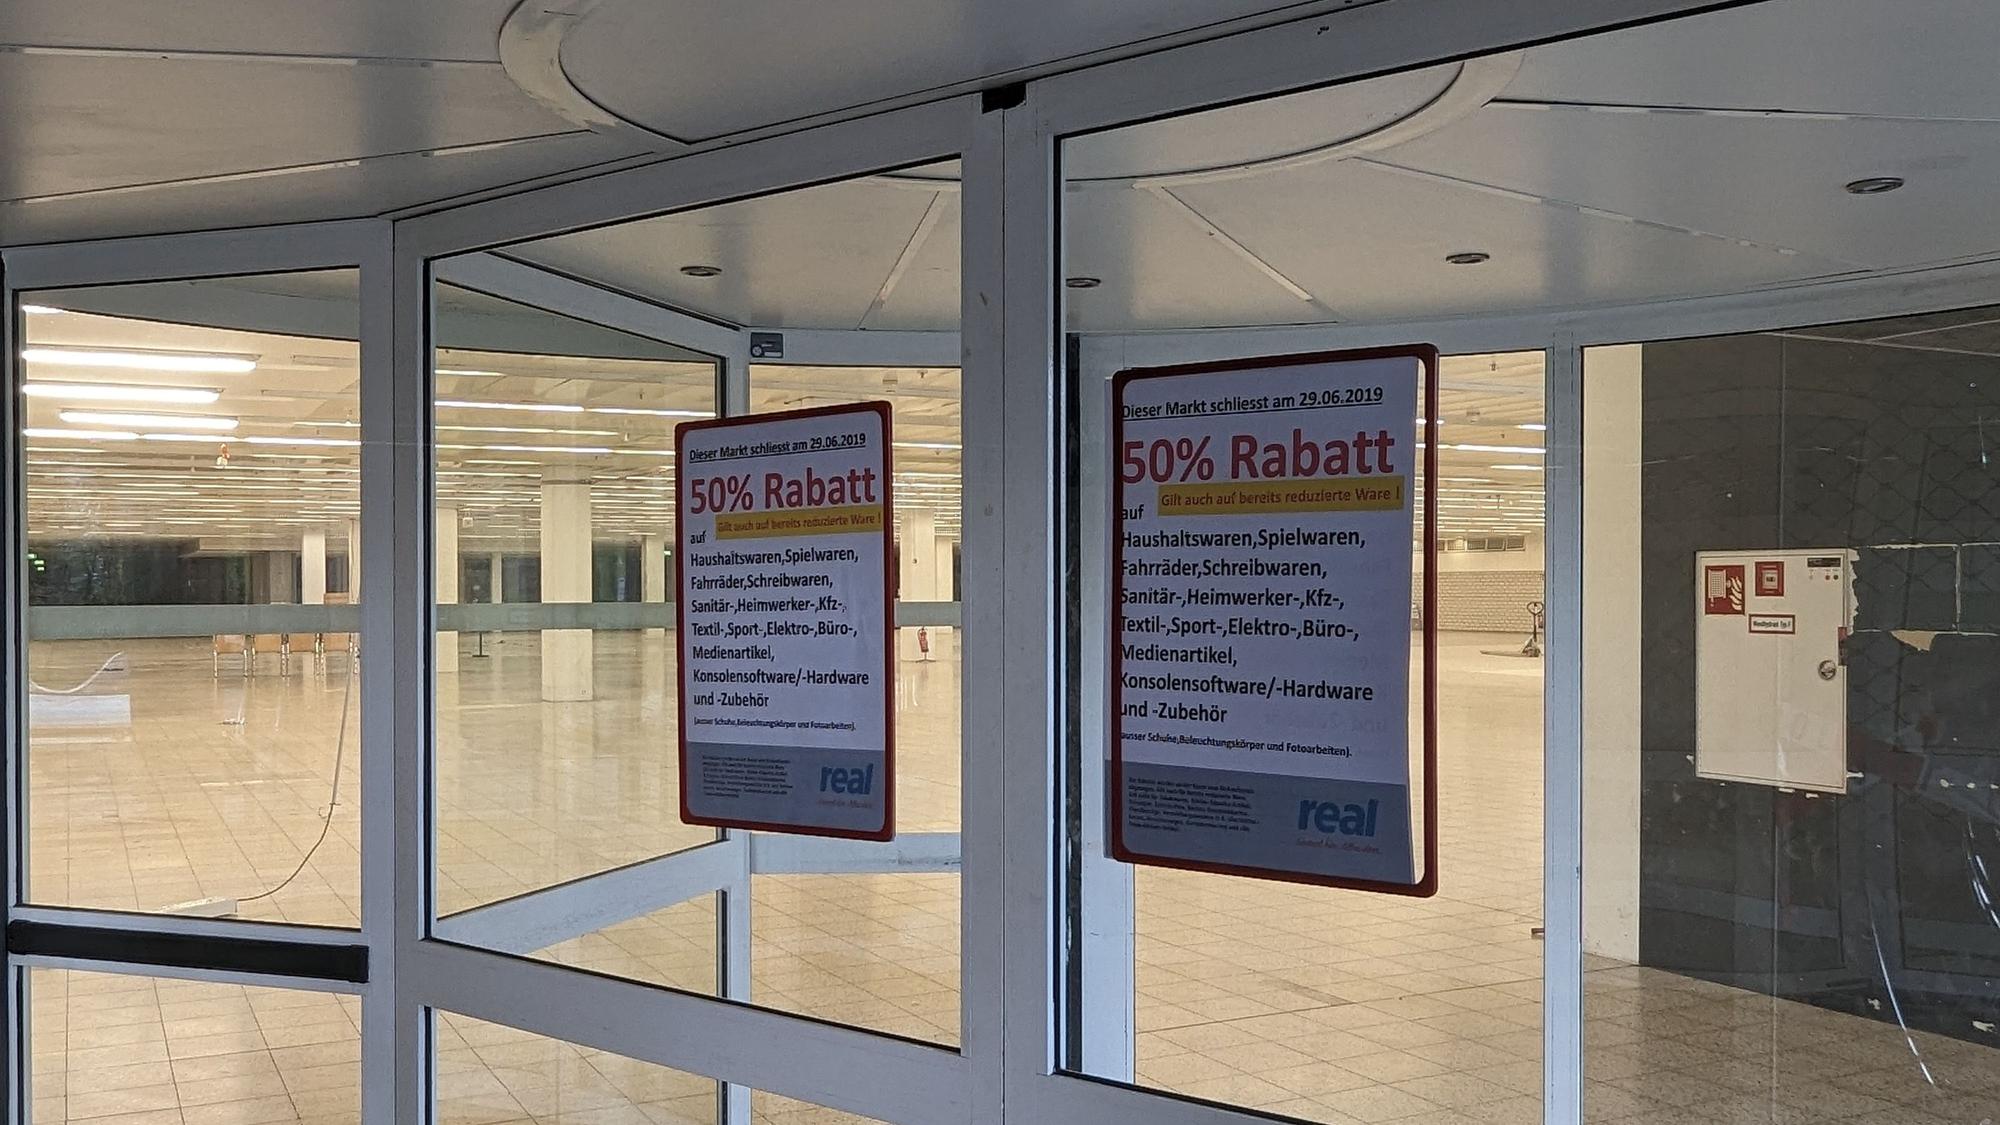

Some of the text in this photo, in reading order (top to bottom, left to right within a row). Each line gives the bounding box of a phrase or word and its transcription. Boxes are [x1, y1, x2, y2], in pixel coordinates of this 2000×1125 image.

[1122, 387, 1383, 419] Dieser Markt schliesst am 29.06.2019
[689, 433, 866, 461] Dieser Markt schliesst am 29.06.2019
[1122, 428, 1395, 484] 50% Rabatt
[691, 467, 876, 514] 50% Rabatt
[1161, 492, 1181, 506] Gilt
[1185, 492, 1213, 505] auch
[1216, 491, 1236, 505] auf
[1240, 489, 1280, 504] bereits
[1285, 488, 1351, 503] reduzierte
[1355, 487, 1391, 500] Ware
[771, 516, 801, 529] bereits
[803, 514, 848, 528] reduzierte
[851, 512, 875, 525] Ware
[1120, 504, 1144, 520] auf
[690, 529, 707, 545] auf
[691, 548, 859, 567] Haushaltswaren,Spielwaren,
[691, 573, 834, 591] Fahrräder,Schreibwaren,
[692, 645, 775, 662] Medienartikel,
[1120, 644, 1238, 667] Medienartikel,
[693, 668, 870, 687] Konsolensoftware/-Hardware
[1120, 672, 1373, 701] Konsolensoftware/-Hardware
[694, 692, 770, 707] und -Zubehör
[1120, 701, 1228, 722] und -Zubehör
[797, 721, 809, 729] und
[1267, 742, 1284, 752] und
[1286, 743, 1352, 758] Fotoarbeiten).
[820, 763, 874, 796] real
[1298, 799, 1378, 838] real
